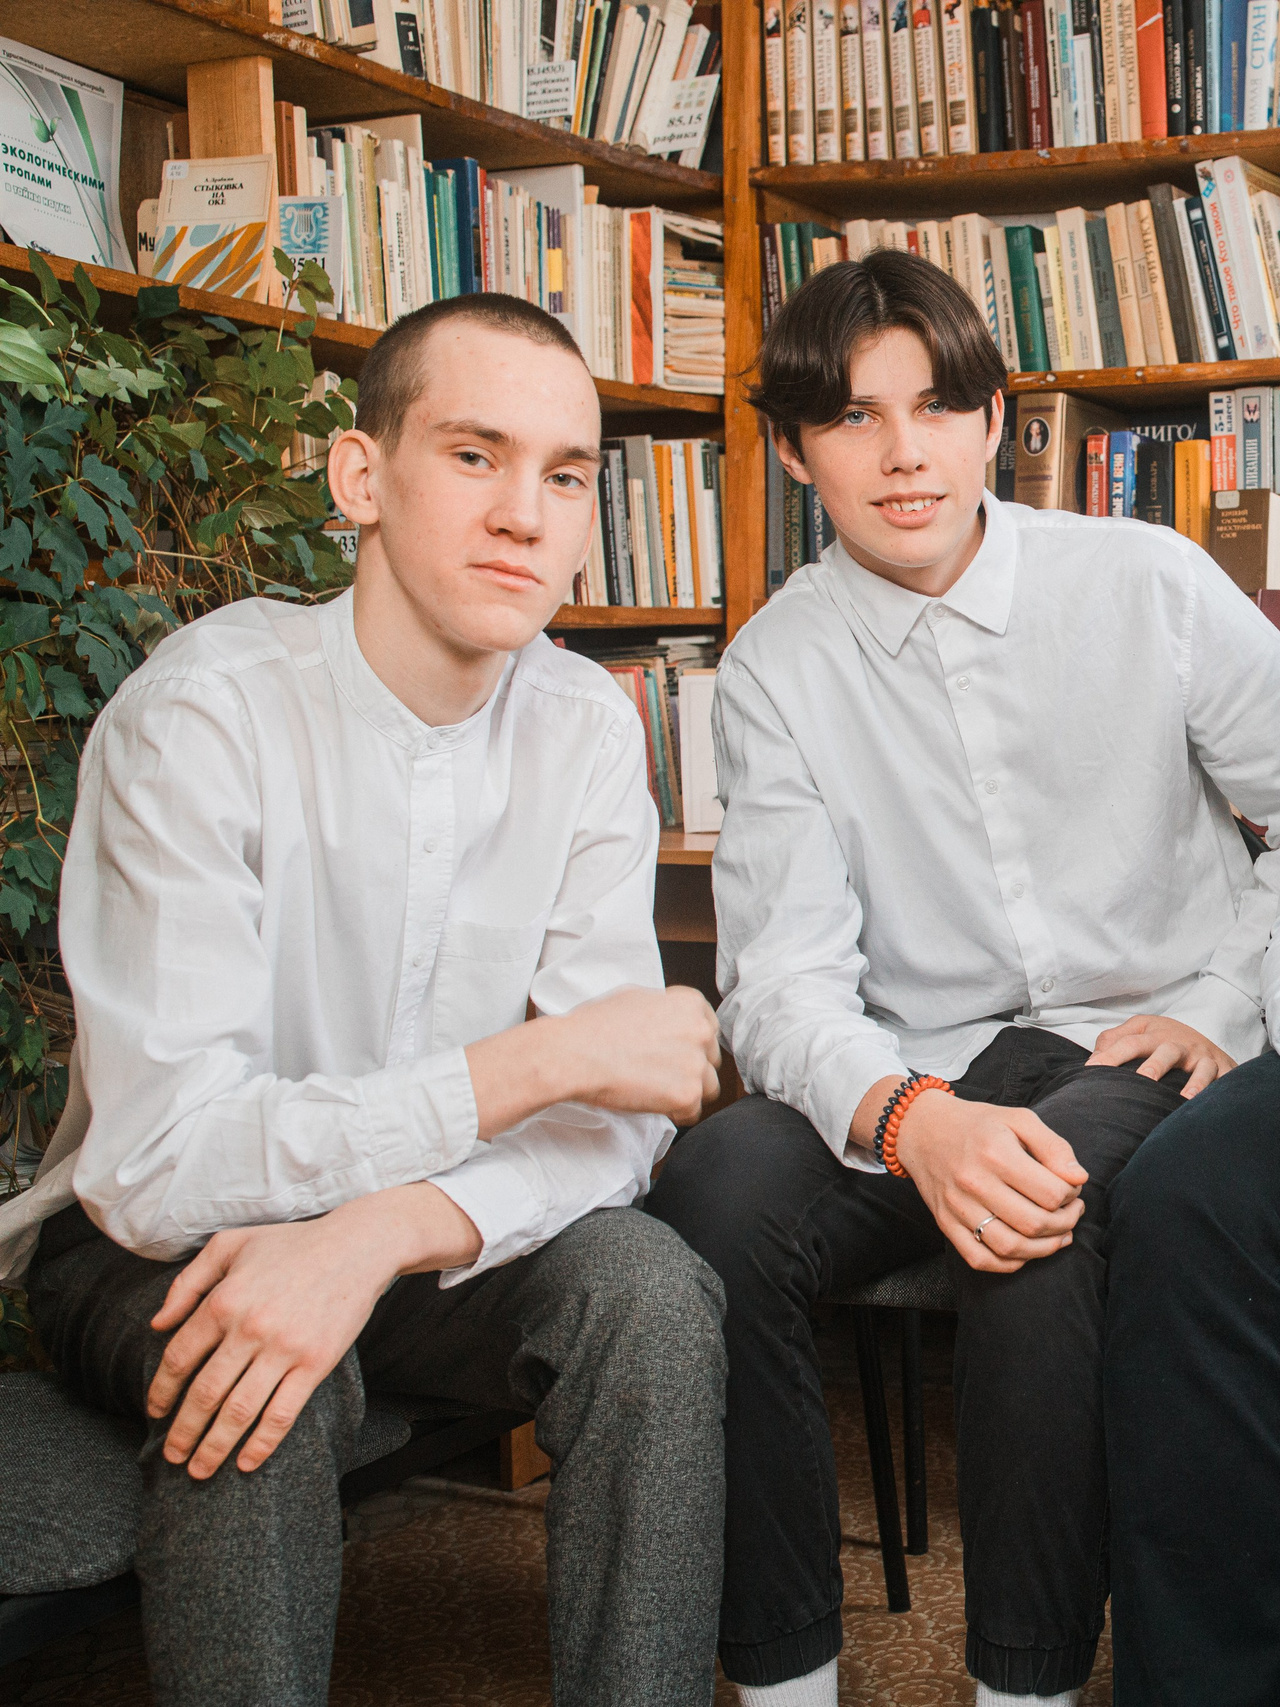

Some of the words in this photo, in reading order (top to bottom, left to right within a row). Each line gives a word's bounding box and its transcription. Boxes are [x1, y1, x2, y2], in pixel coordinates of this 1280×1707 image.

[1123, 4, 1133, 40] ЯЗЫК
[1250, 5, 1266, 69] СТРАН
[1126, 45, 1136, 105] РУССКИЙ
[667, 113, 703, 128] 85.15
[1, 143, 105, 192] ЭКОЛОГИЧЕСКИМИ
[3, 163, 52, 189] ТРОПАМИ
[193, 182, 244, 192] СТЫКОВКА
[212, 191, 225, 199] НА
[1208, 201, 1223, 238] такой
[1140, 214, 1159, 284] ФИЗИКА
[1215, 239, 1229, 263] Кто
[1222, 265, 1237, 304] такое
[1228, 304, 1242, 330] Что
[1214, 398, 1224, 432] 5-11
[1224, 395, 1233, 433] классы
